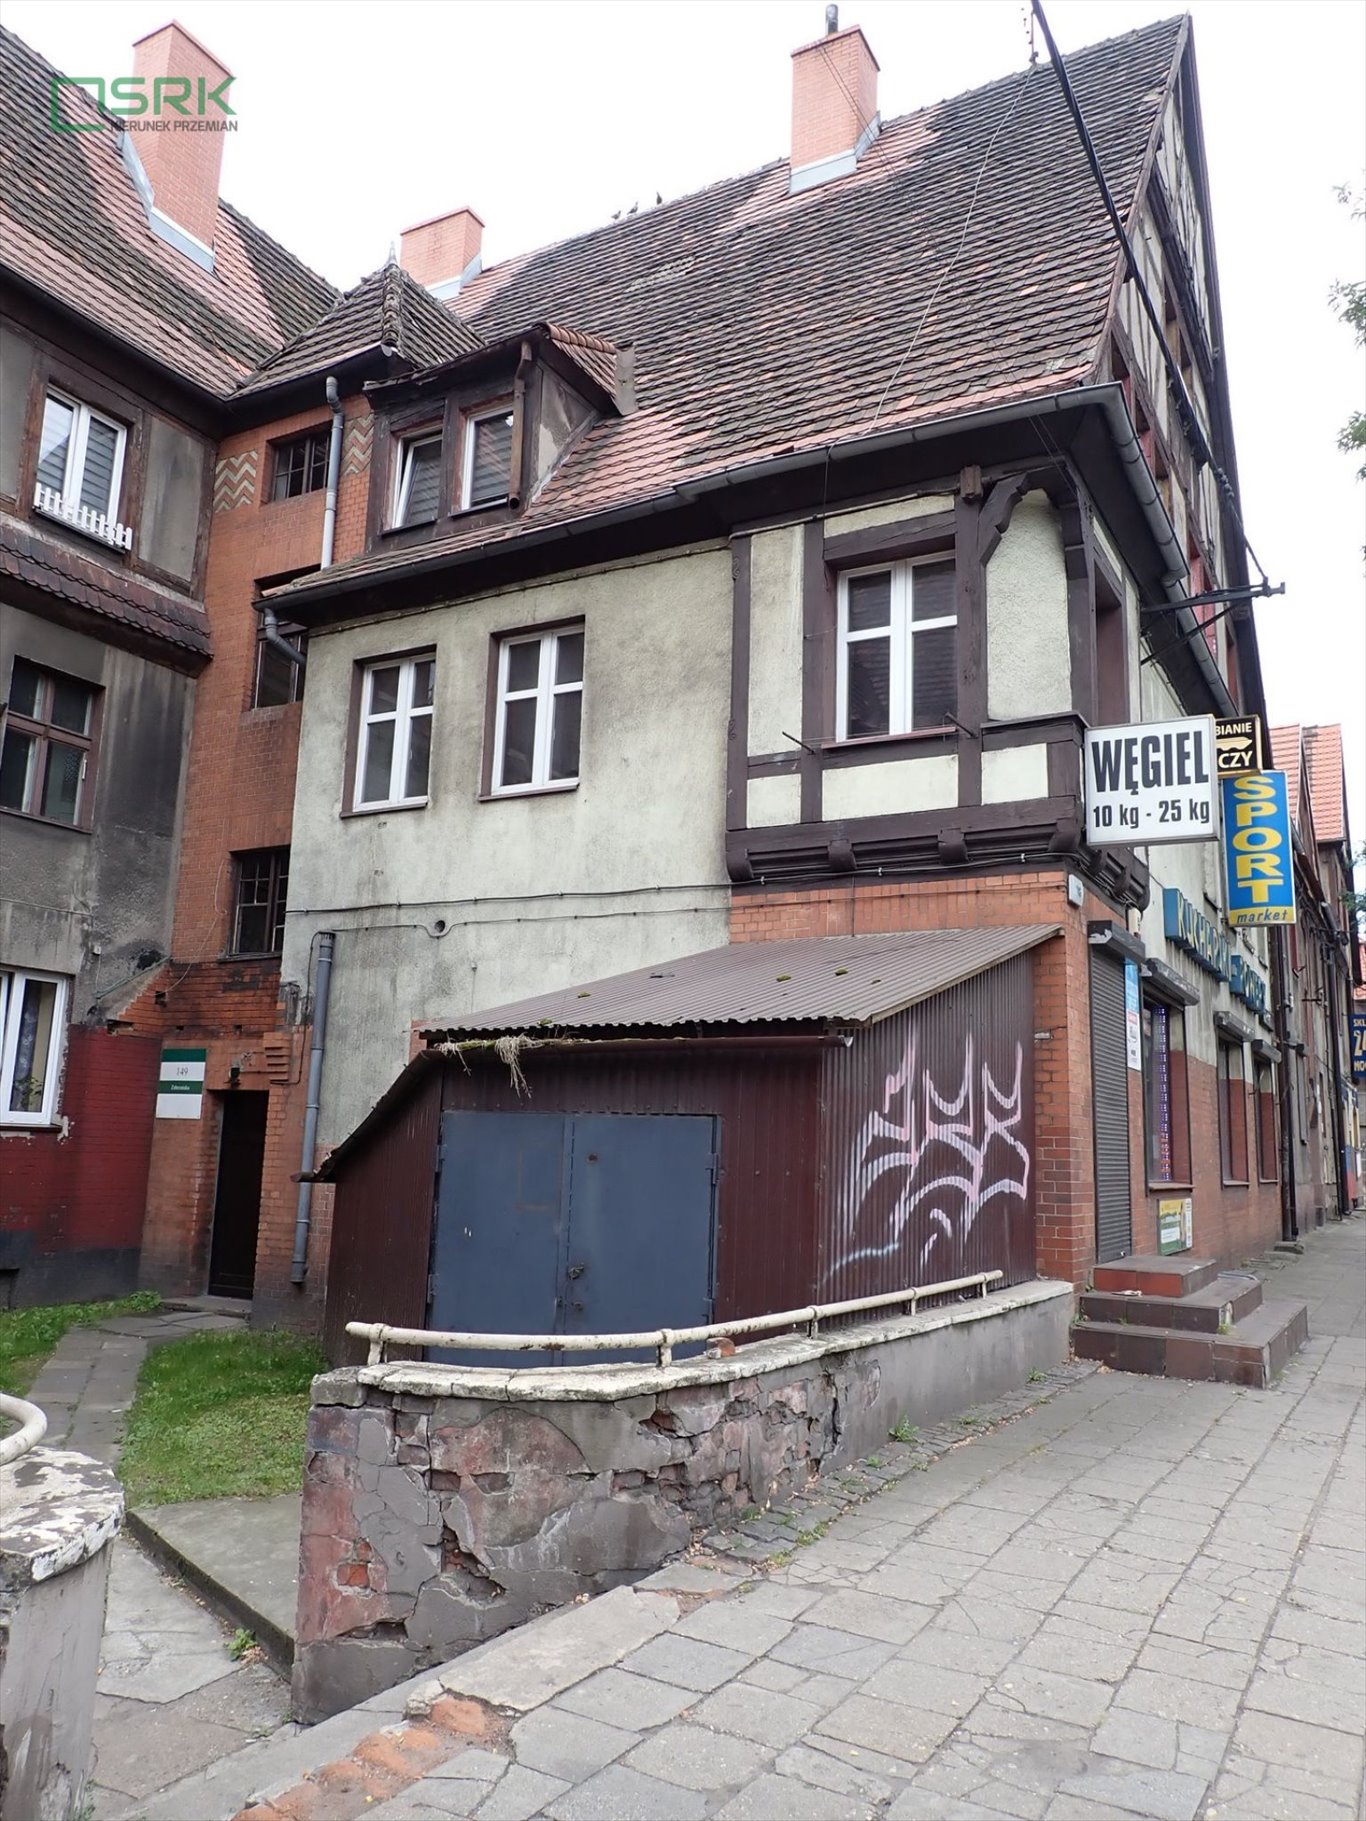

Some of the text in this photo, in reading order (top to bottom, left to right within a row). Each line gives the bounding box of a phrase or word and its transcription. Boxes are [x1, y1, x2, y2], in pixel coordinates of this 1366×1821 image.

[1091, 730, 1210, 796] WĘGIEL
[1218, 751, 1253, 768] CZY
[1093, 805, 1113, 828] 10
[1119, 804, 1139, 829] kg
[1158, 800, 1182, 823] 25
[1189, 799, 1210, 824] kg
[1232, 775, 1284, 904] SPORT
[1236, 909, 1289, 924] market
[176, 1067, 189, 1077] 149
